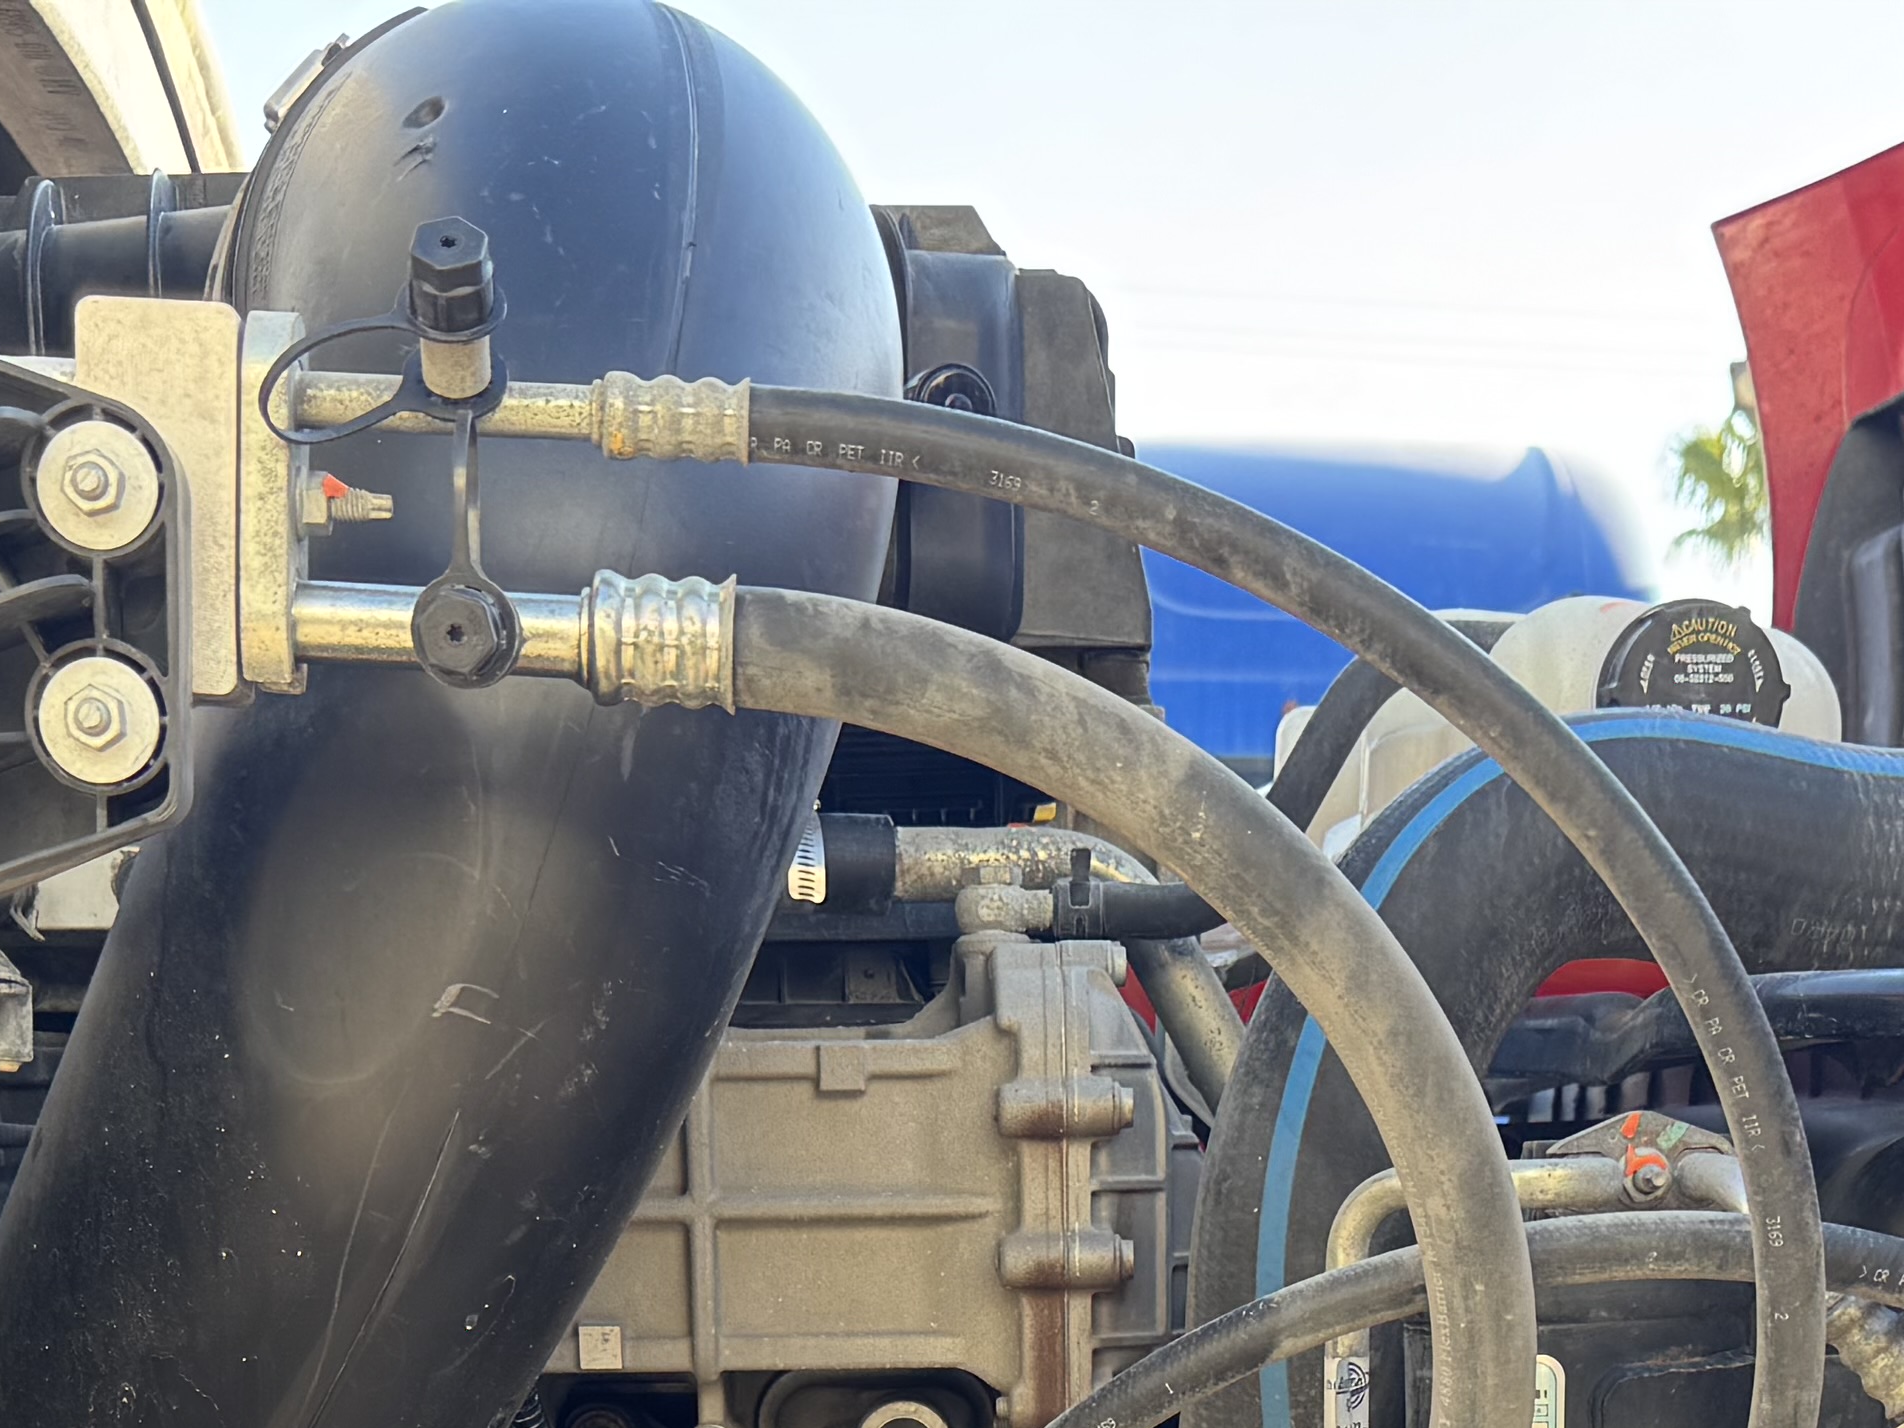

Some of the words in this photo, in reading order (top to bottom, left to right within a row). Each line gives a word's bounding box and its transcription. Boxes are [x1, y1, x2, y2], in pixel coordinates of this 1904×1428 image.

[839, 443, 865, 461] PET
[1682, 618, 1738, 638] CAUTION
[1675, 653, 1734, 664] PRESSURIZED
[1687, 664, 1723, 674] SYSTEM
